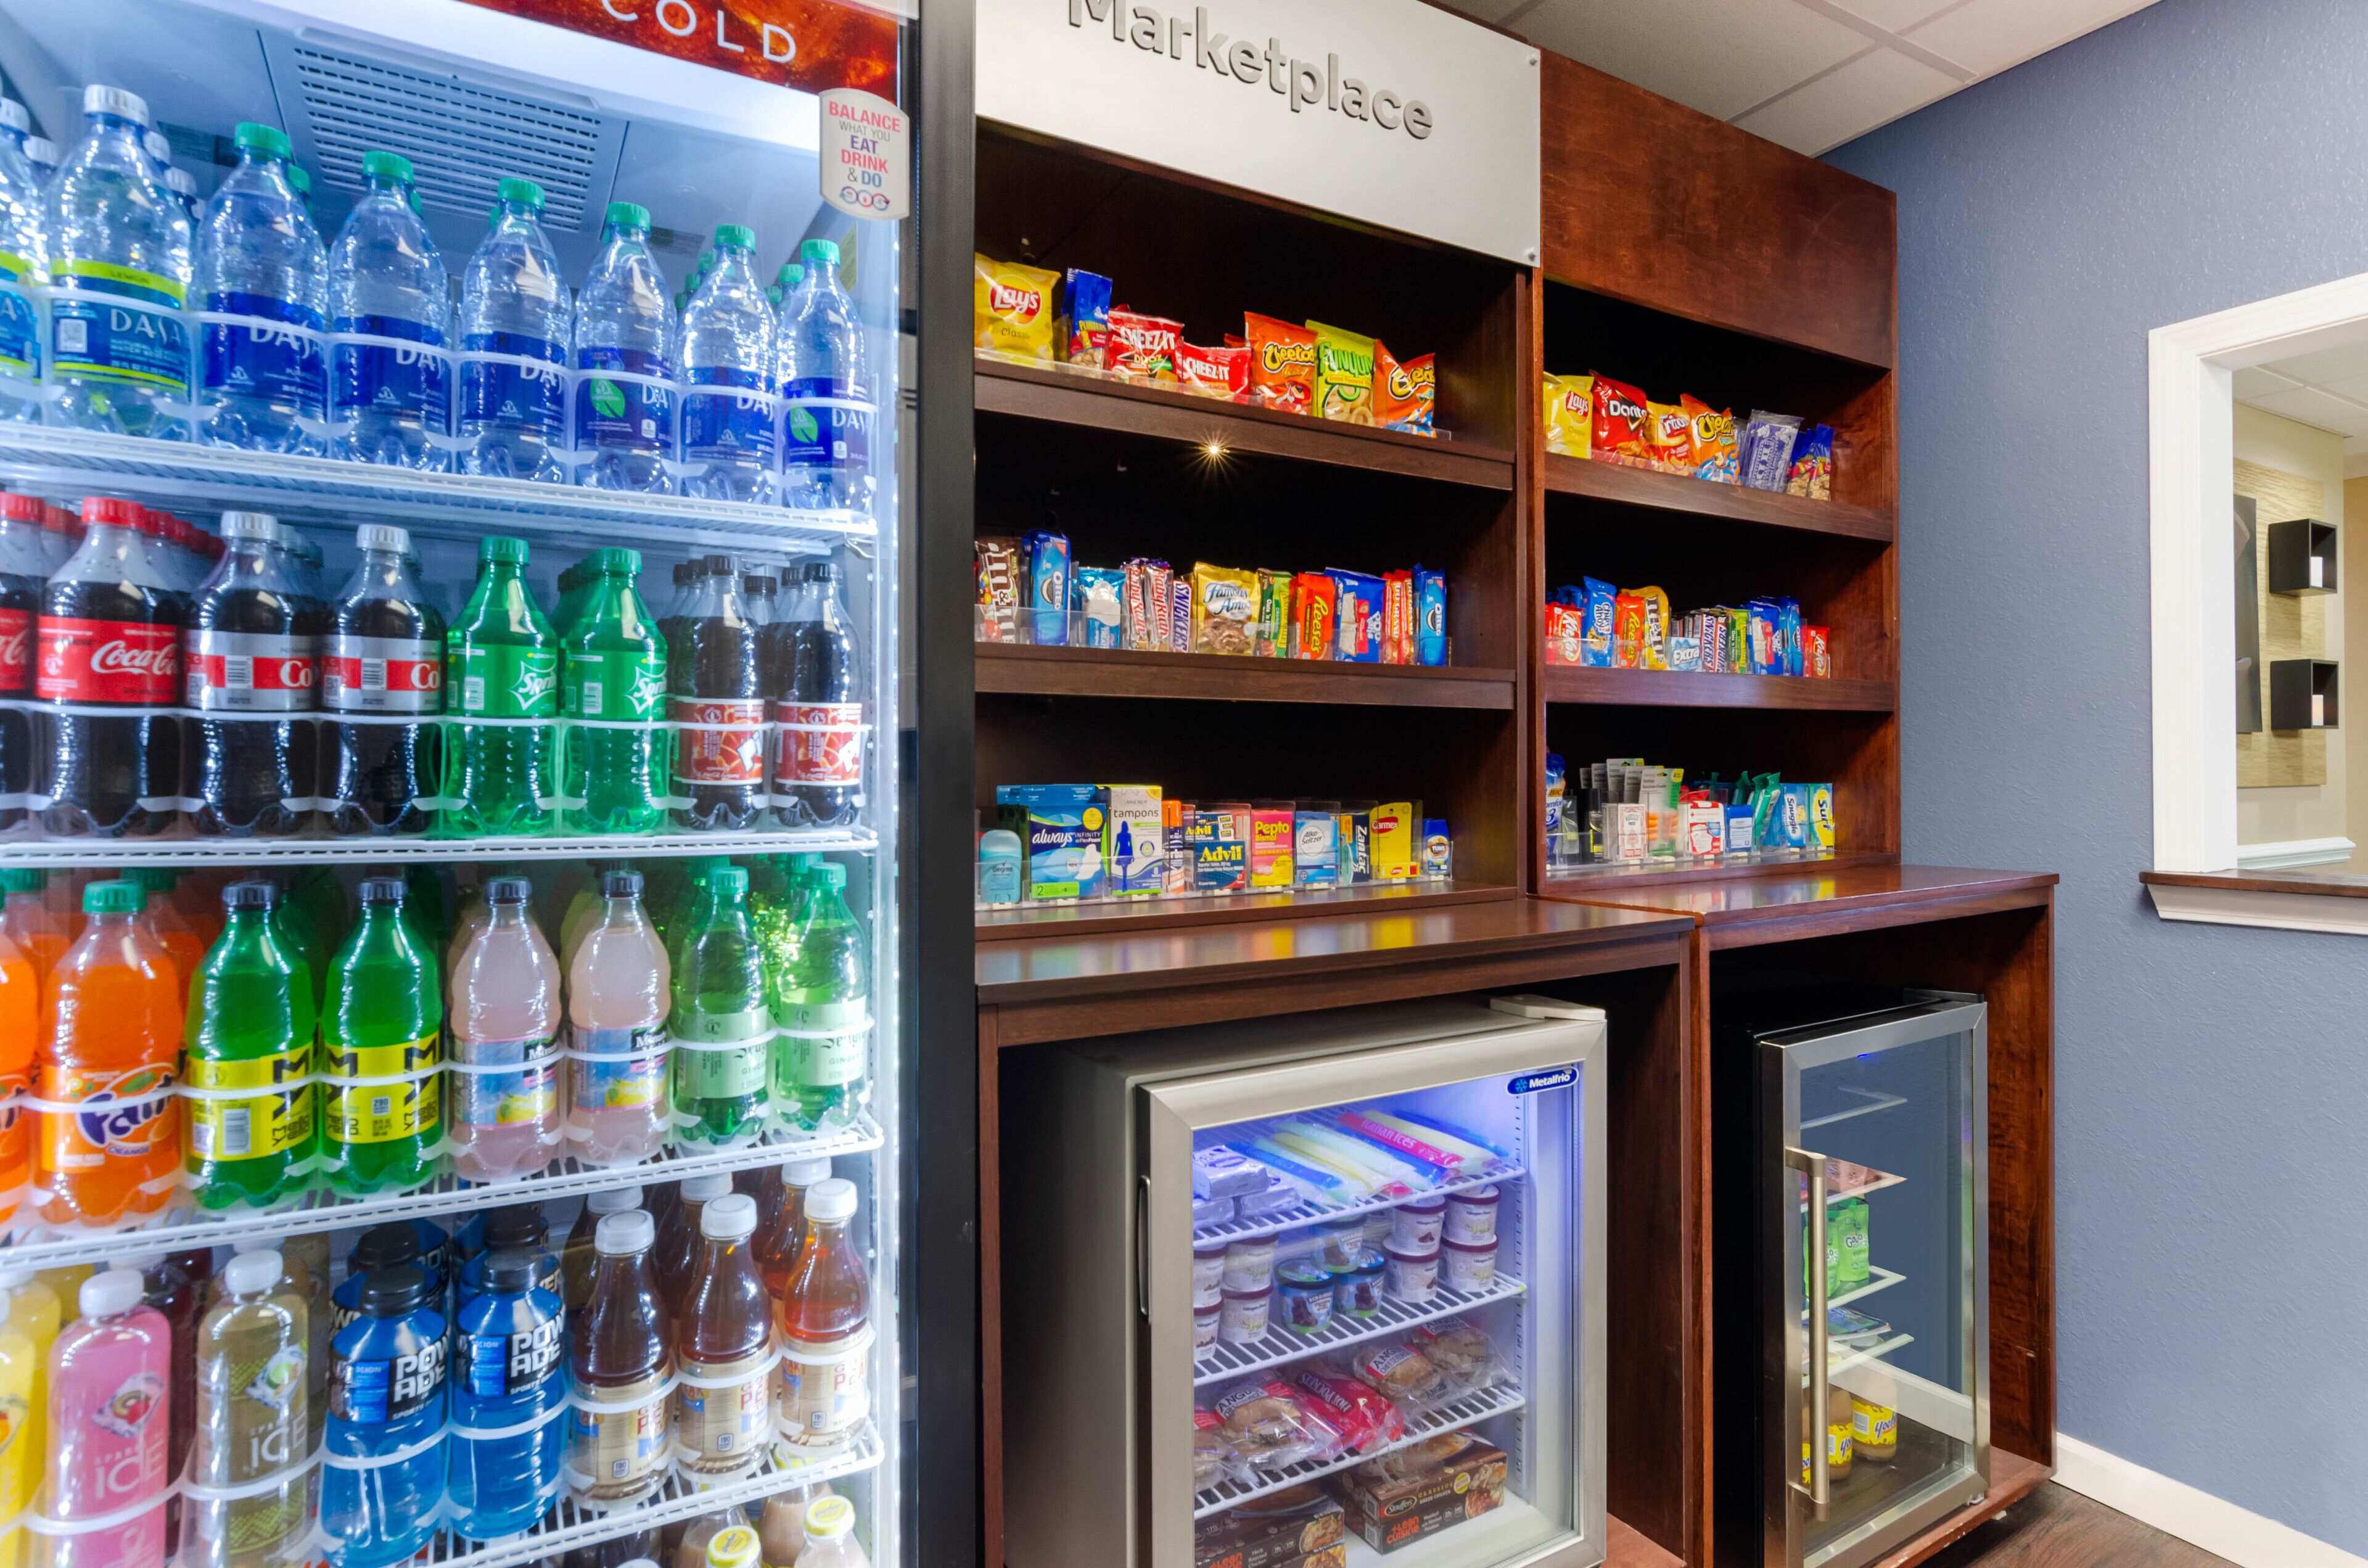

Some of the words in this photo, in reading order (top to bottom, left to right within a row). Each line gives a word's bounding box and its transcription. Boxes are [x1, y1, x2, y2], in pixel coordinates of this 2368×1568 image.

[601, 0, 796, 64] COLD
[1069, 0, 1433, 139] Marketplace
[829, 101, 900, 133] BALANCE
[839, 120, 867, 134] WHAT
[871, 128, 890, 142] YOU
[841, 149, 888, 174] DRINK
[847, 167, 858, 183] &
[861, 170, 882, 187] DO
[994, 284, 1039, 310] Lay's
[1568, 391, 1589, 416] Lay's
[1052, 570, 1064, 610] OREO
[1204, 581, 1248, 603] Famous
[1174, 581, 1190, 652] SNICKERS
[1434, 602, 1442, 636] OREO
[1602, 602, 1611, 627] Chips
[1703, 615, 1716, 668] SNICKERS
[1114, 809, 1159, 819] tampons
[1371, 819, 1398, 830] Carmex
[1546, 808, 1556, 823] 3
[1786, 797, 1797, 835] Snuggle
[1818, 799, 1833, 832] Surf
[1032, 828, 1074, 848] always
[1255, 821, 1290, 836] Pepto
[1255, 834, 1277, 842] Bismol
[1301, 835, 1323, 845] Seltzer
[1356, 824, 1367, 874] Zantac
[1199, 845, 1243, 863] Advil
[992, 865, 1013, 874] Degree
[1037, 886, 1044, 896] 2
[1529, 1073, 1571, 1088] Metalfrio
[373, 1097, 389, 1108] 290
[1394, 1132, 1416, 1149] Ices
[510, 1342, 561, 1378] ADE
[393, 1364, 446, 1403] ADE
[392, 1404, 424, 1421] SPORTS
[1330, 1392, 1353, 1413] HOT
[1433, 1490, 1451, 1501] CHICKEN
[1251, 1548, 1264, 1556] Herb
